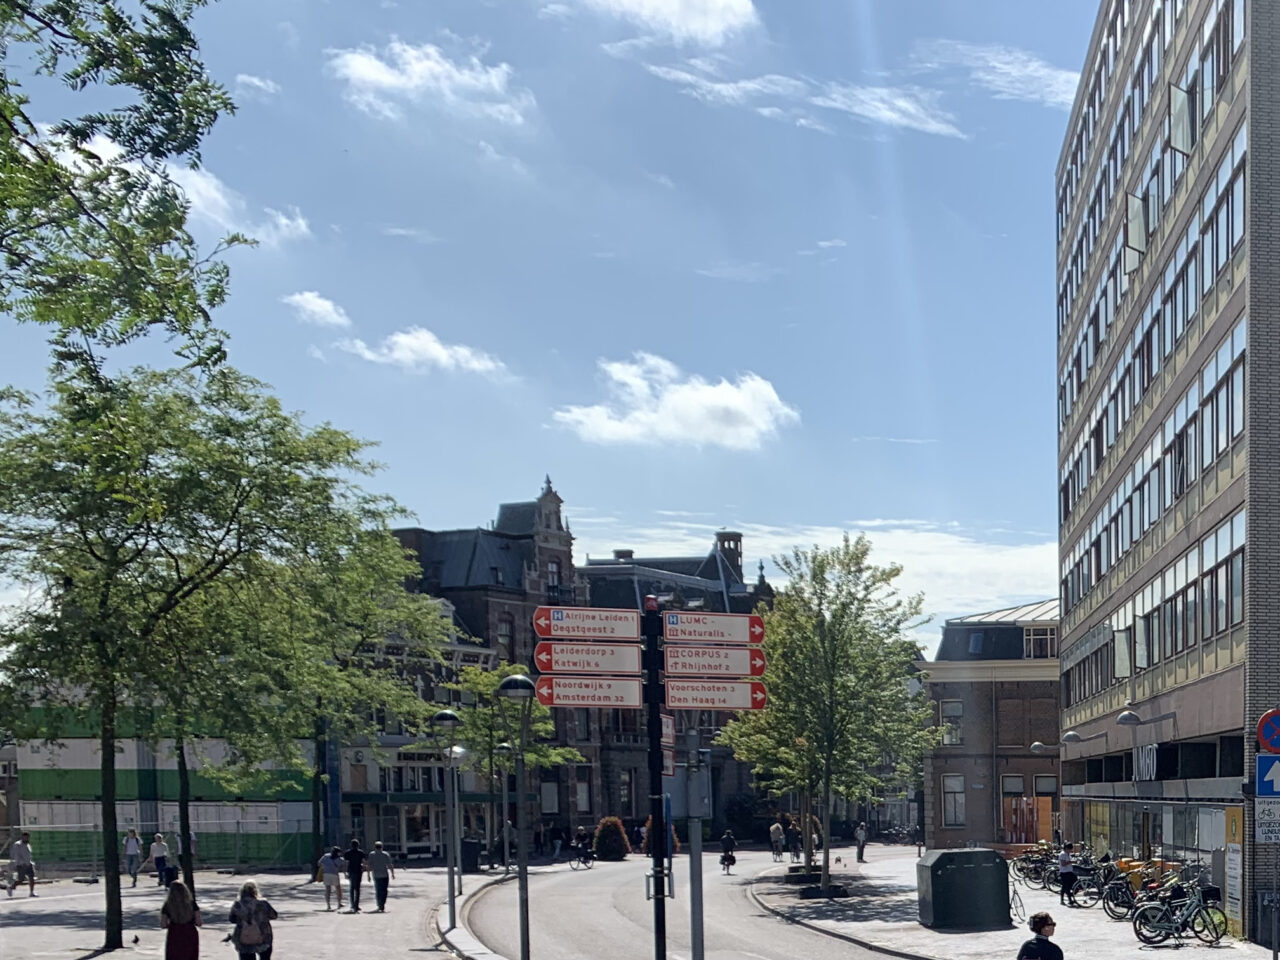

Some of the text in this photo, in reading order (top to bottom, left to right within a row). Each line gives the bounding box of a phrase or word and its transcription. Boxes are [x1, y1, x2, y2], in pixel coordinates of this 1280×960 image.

[599, 613, 629, 622] Leiden
[680, 616, 708, 625] LUMC
[552, 624, 607, 634] Oegstgeest
[680, 628, 725, 638] Naturalis
[553, 647, 607, 656] Leiderdorp
[680, 650, 721, 658] CORPUS
[554, 659, 593, 669] Katwijk
[681, 662, 723, 671] Rhijnhof
[554, 681, 603, 691] Noordwijk
[669, 683, 728, 692] Voorschoten
[554, 693, 611, 702] Amsterdam
[670, 695, 688, 703] Den
[691, 696, 716, 705] Haag
[1132, 744, 1158, 781] JUMBO
